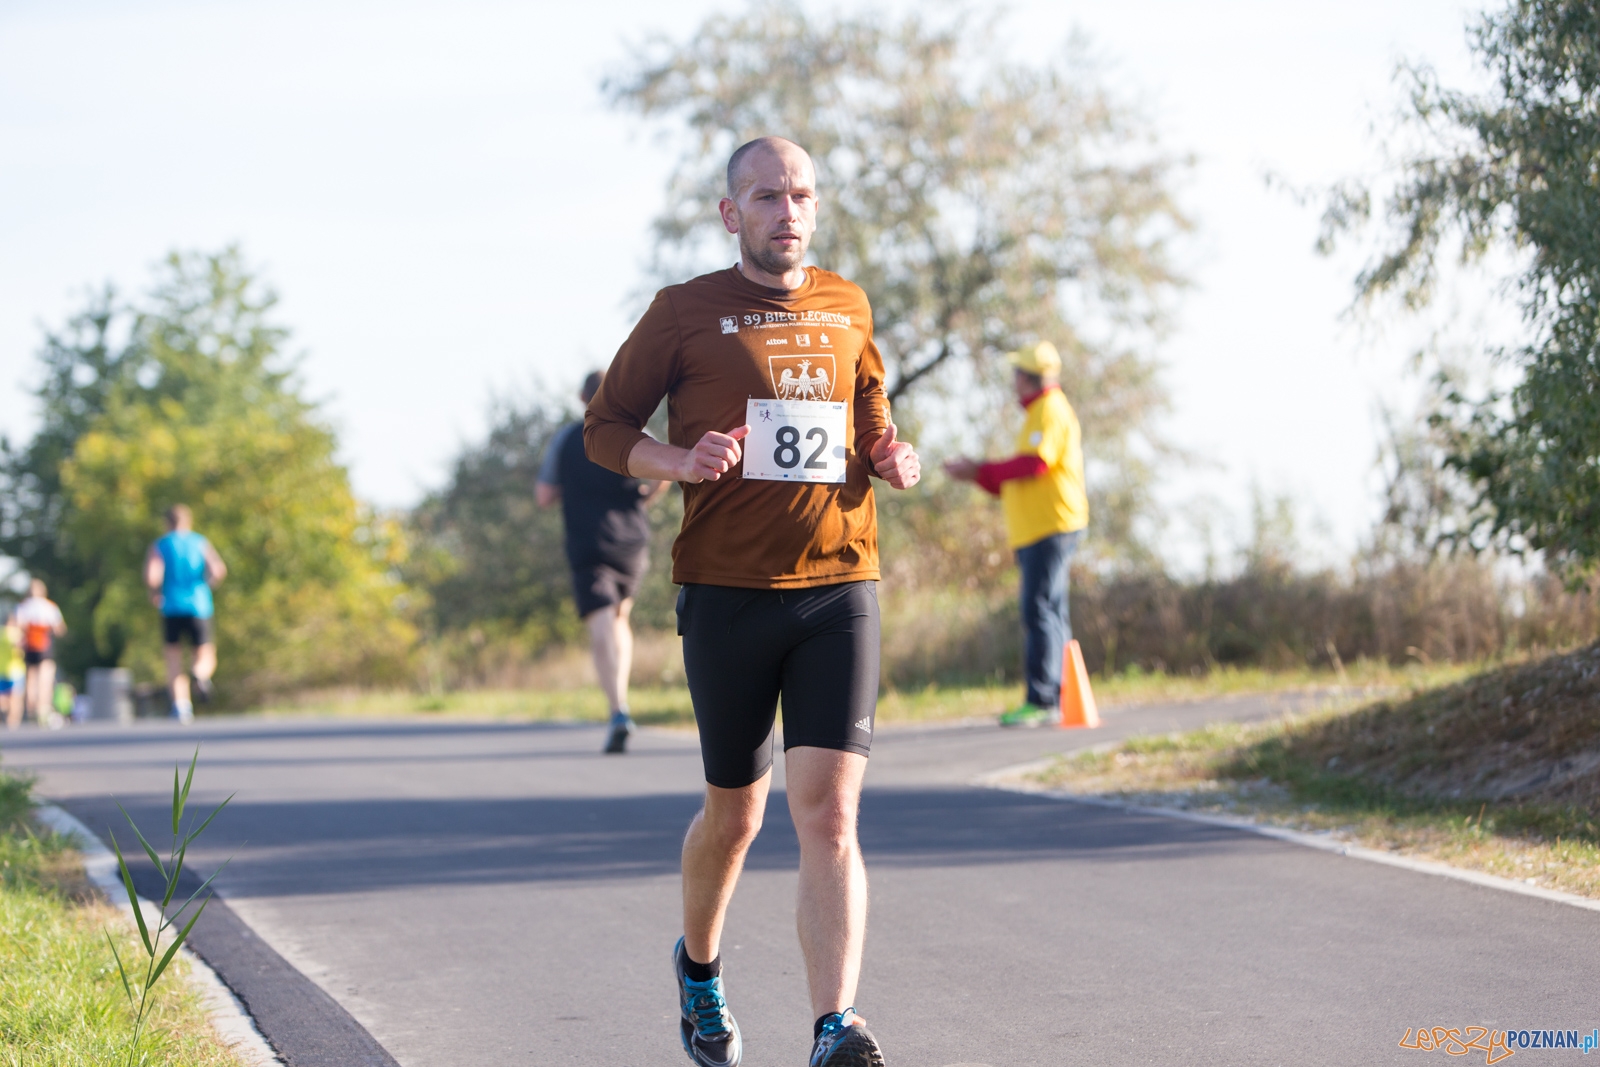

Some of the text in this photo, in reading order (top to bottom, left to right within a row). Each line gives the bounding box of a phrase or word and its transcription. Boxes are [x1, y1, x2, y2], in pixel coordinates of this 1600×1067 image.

[744, 314, 761, 325] 39
[765, 312, 797, 323] BIEG
[801, 311, 850, 326] LECHITÓW
[773, 425, 829, 470] 82
